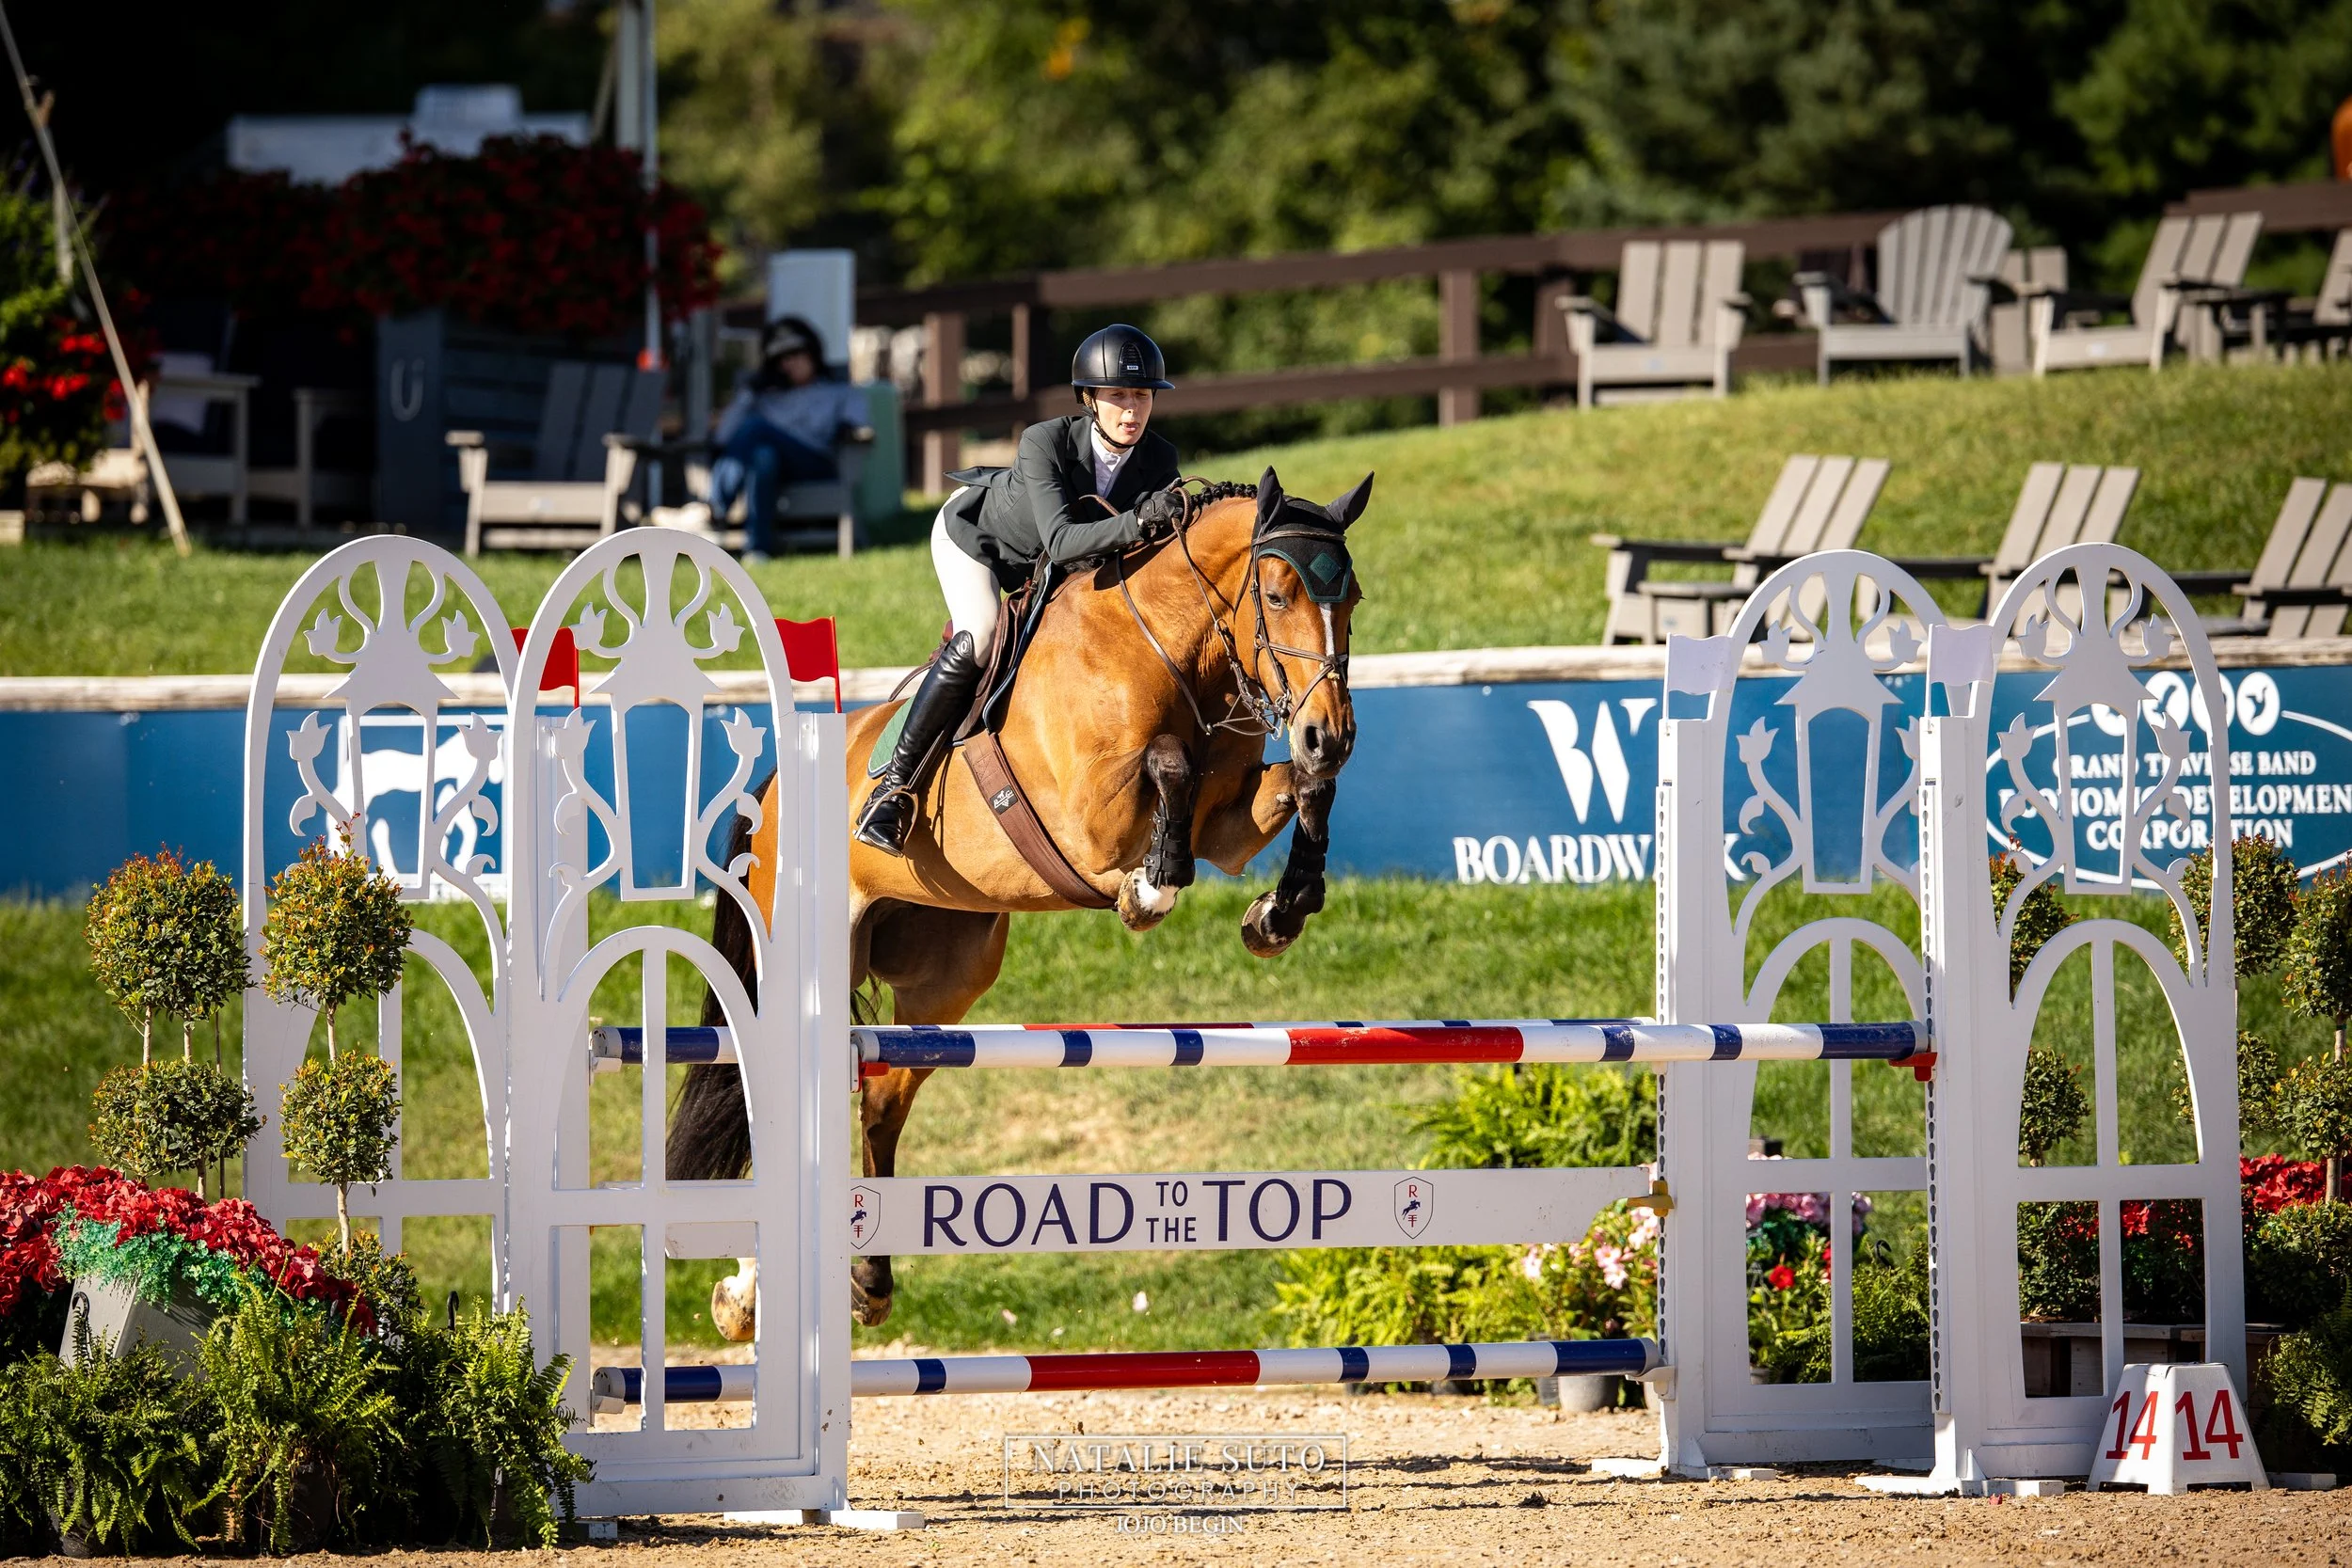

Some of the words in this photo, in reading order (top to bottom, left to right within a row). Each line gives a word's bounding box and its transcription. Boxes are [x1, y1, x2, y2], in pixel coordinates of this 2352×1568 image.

[2257, 751, 2316, 776] BAND
[1453, 833, 1747, 884] BOARDWK
[924, 1182, 1134, 1247] ROAD
[1155, 1180, 1188, 1207] TO
[1202, 1179, 1352, 1242] TOP
[1145, 1216, 1197, 1243] THE
[2106, 1390, 2159, 1460] 14
[2175, 1389, 2243, 1460] 14
